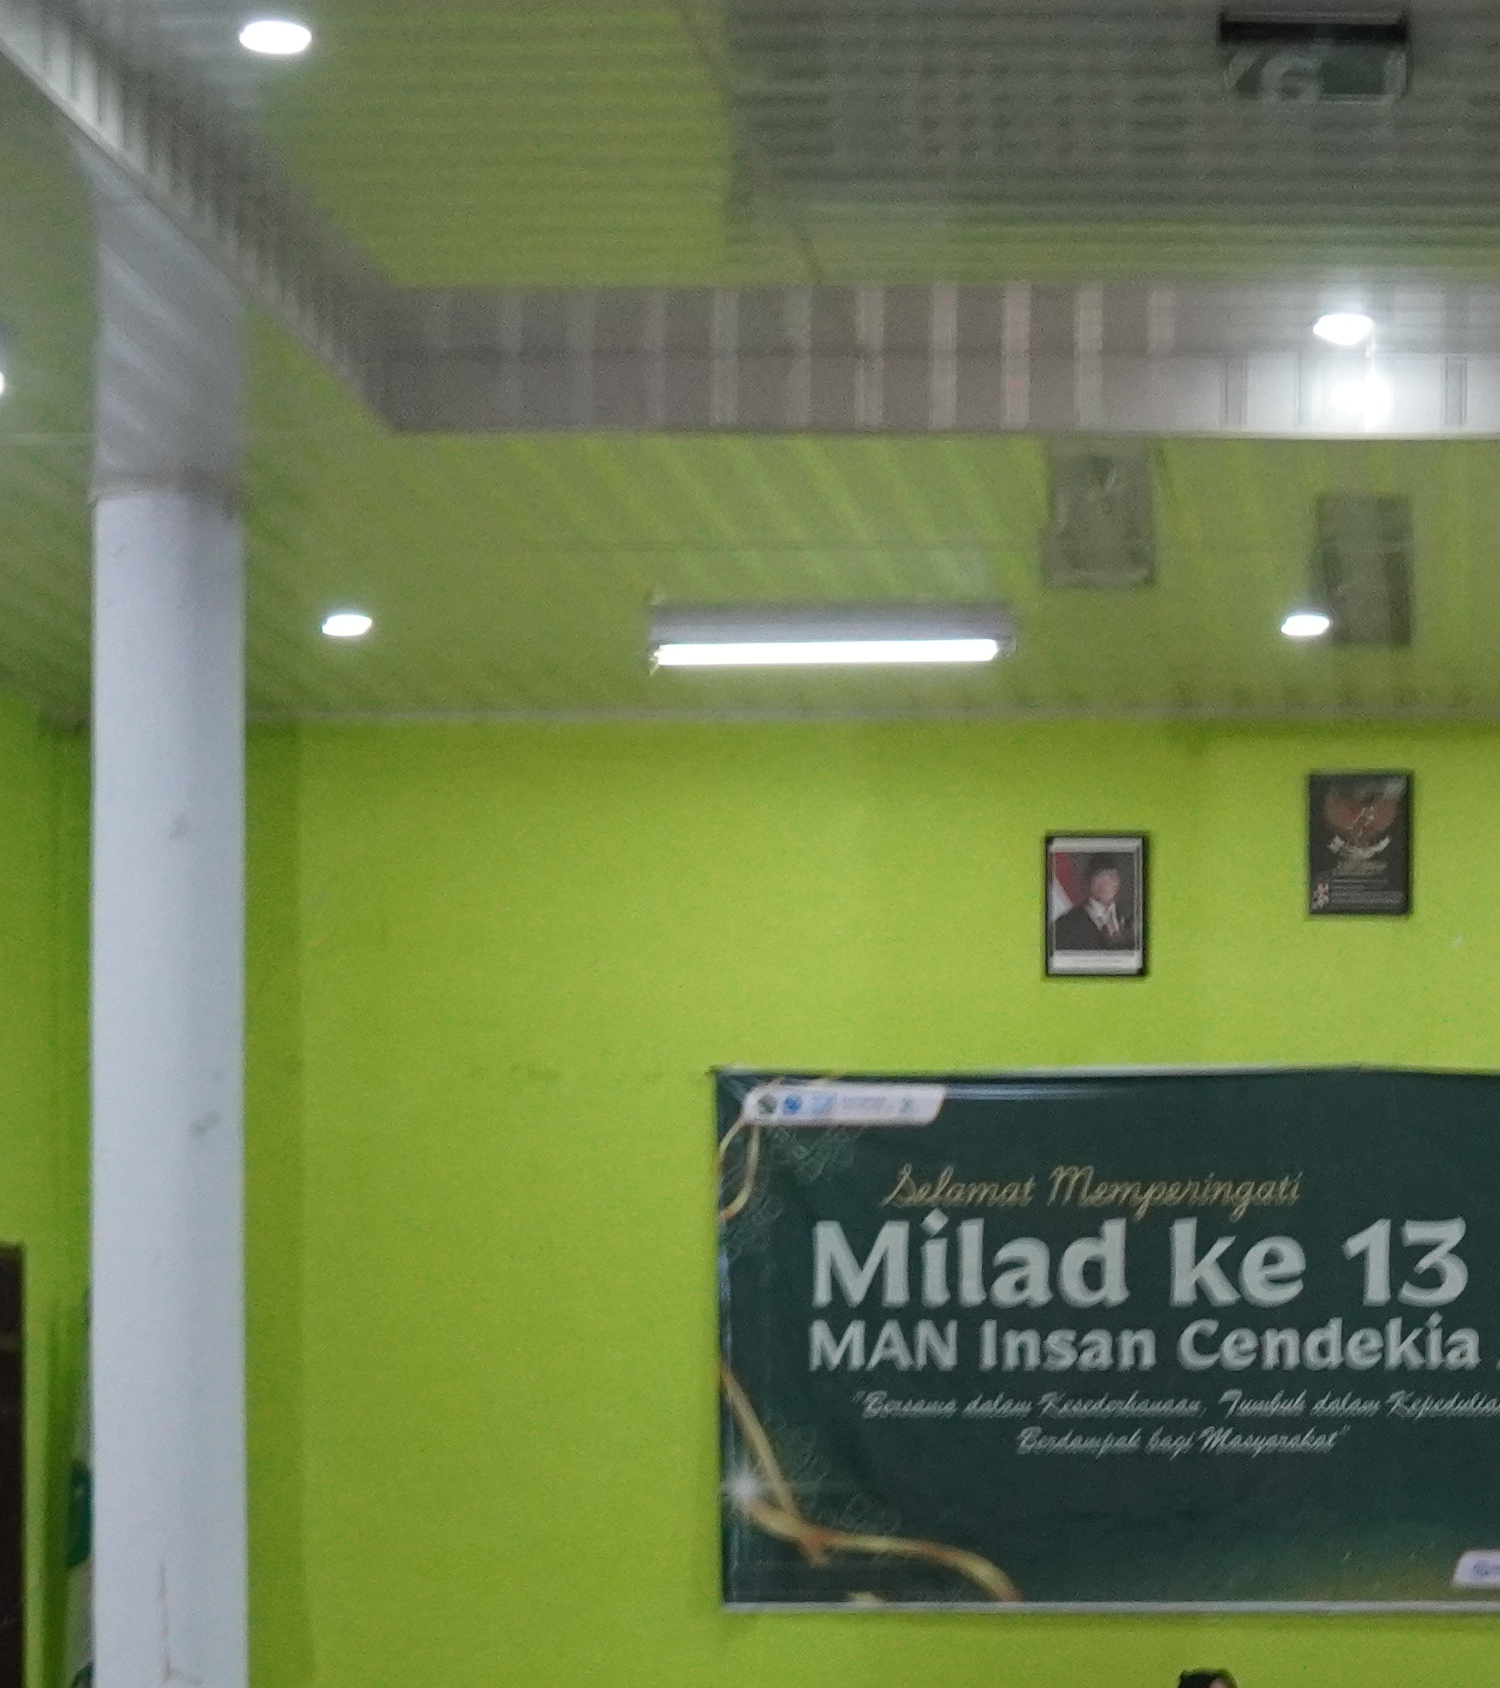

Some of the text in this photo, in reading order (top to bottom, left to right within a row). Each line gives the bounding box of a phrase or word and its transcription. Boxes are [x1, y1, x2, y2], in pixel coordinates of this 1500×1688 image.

[883, 1162, 1304, 1224] Selamat Memperingati
[811, 1208, 1470, 1308] Milad ke 13
[808, 1318, 958, 1372] MAN
[979, 1318, 1157, 1372] Insan
[1177, 1311, 1481, 1371] Cendekia
[962, 1392, 1033, 1419] dalam
[1310, 1390, 1381, 1418] dalam
